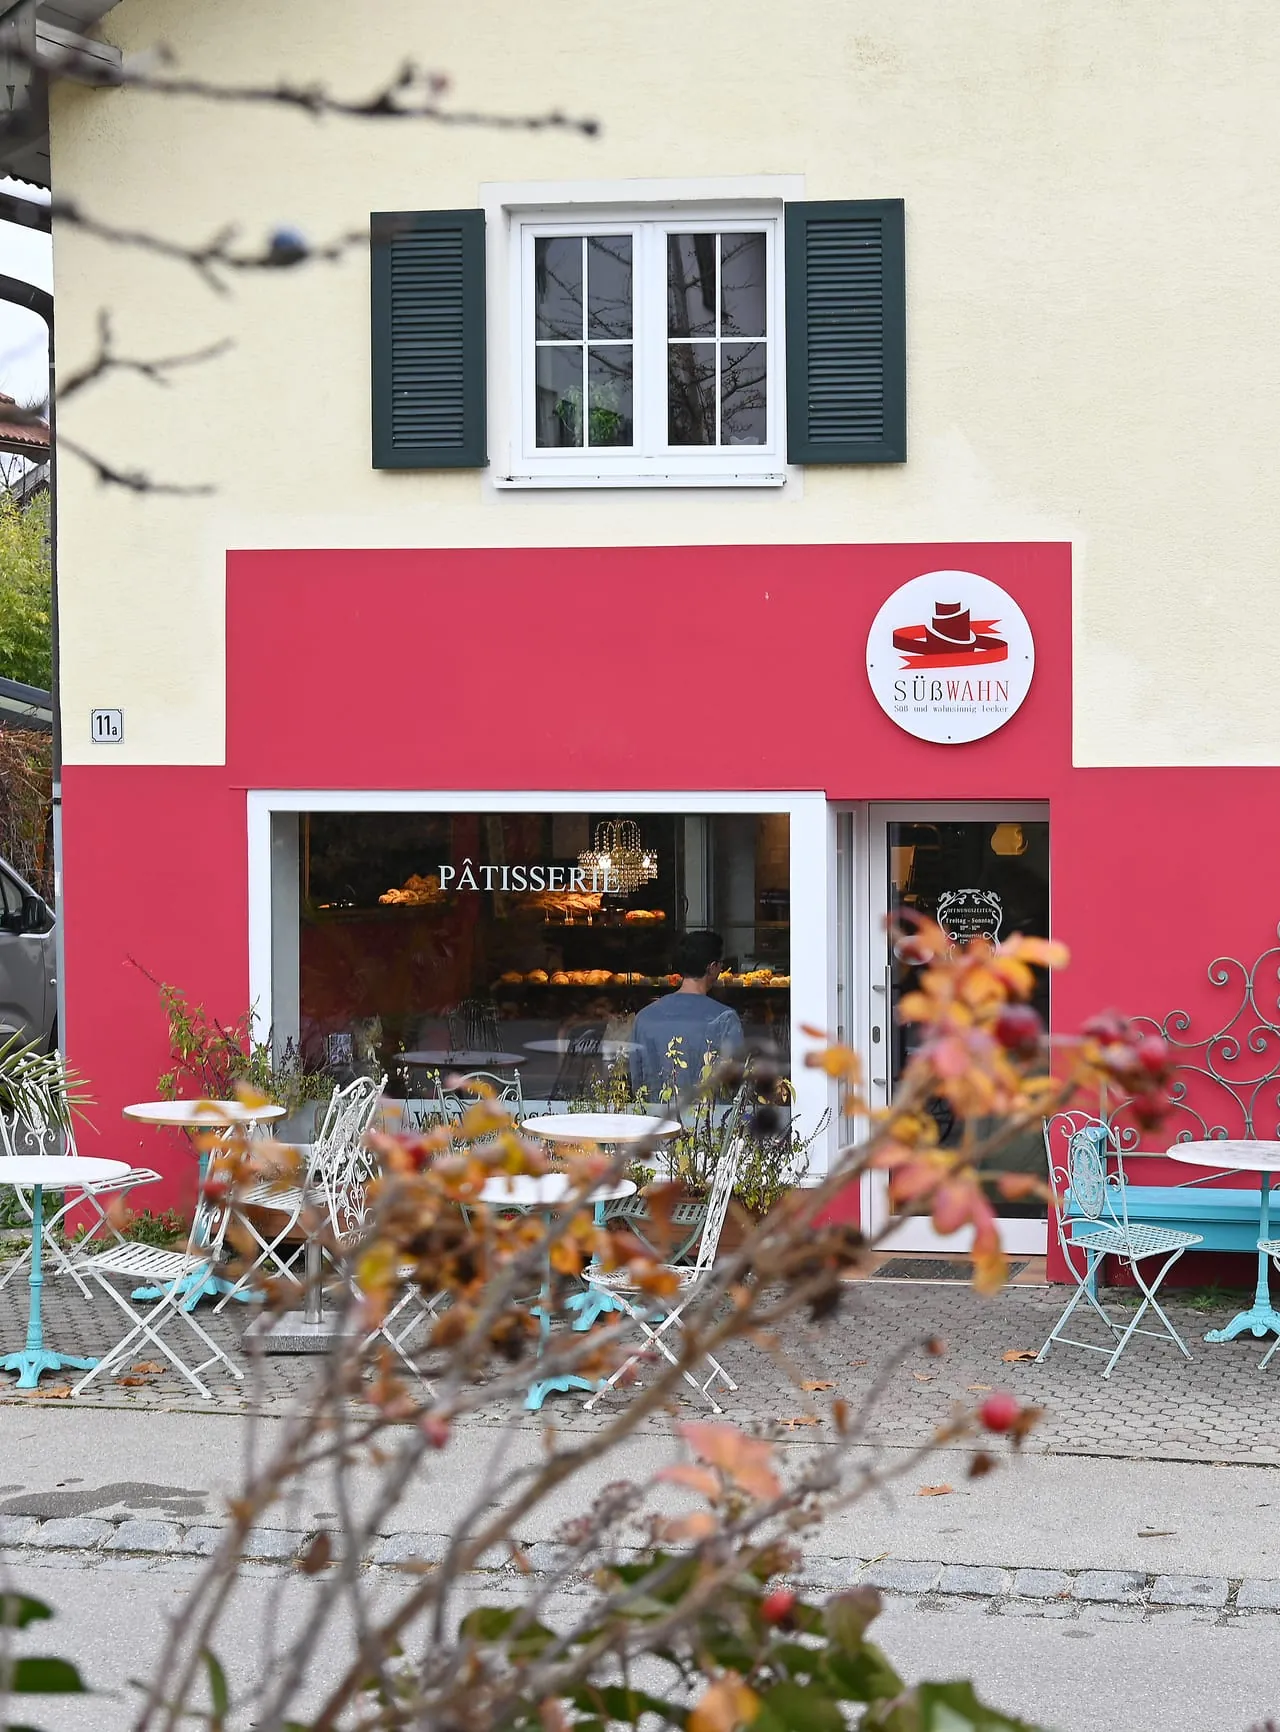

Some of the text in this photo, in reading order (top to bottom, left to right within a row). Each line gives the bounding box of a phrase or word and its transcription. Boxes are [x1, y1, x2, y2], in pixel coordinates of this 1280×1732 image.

[914, 704, 928, 713] und
[932, 704, 977, 713] wahnsinnig
[982, 704, 1008, 713] lecker
[96, 714, 118, 736] 11a
[437, 857, 620, 893] PÂTISSERIE
